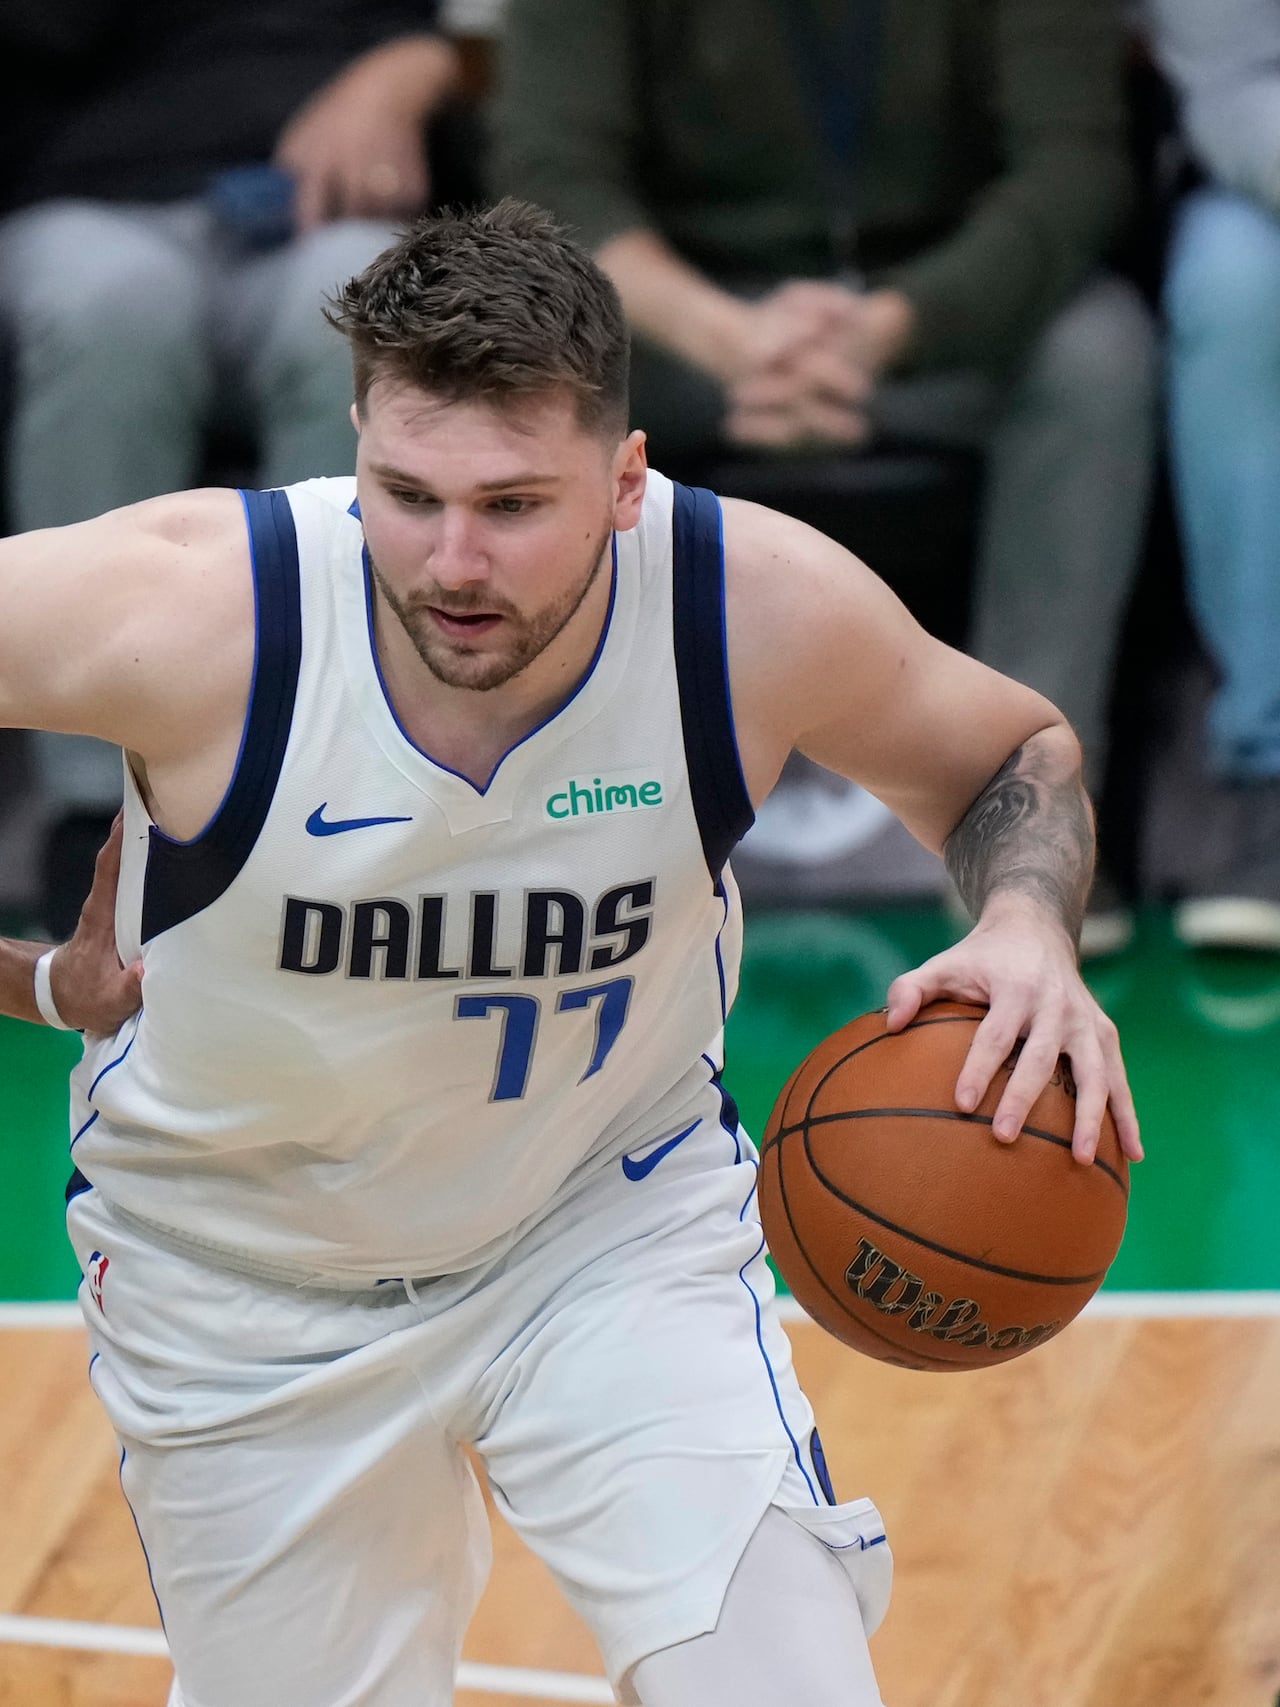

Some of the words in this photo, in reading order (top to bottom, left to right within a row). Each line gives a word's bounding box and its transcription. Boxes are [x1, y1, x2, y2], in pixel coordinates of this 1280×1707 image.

[546, 778, 663, 819] chime
[276, 876, 657, 981] DALLAS
[452, 975, 635, 1104] 77
[845, 1237, 1061, 1351] Wilson
